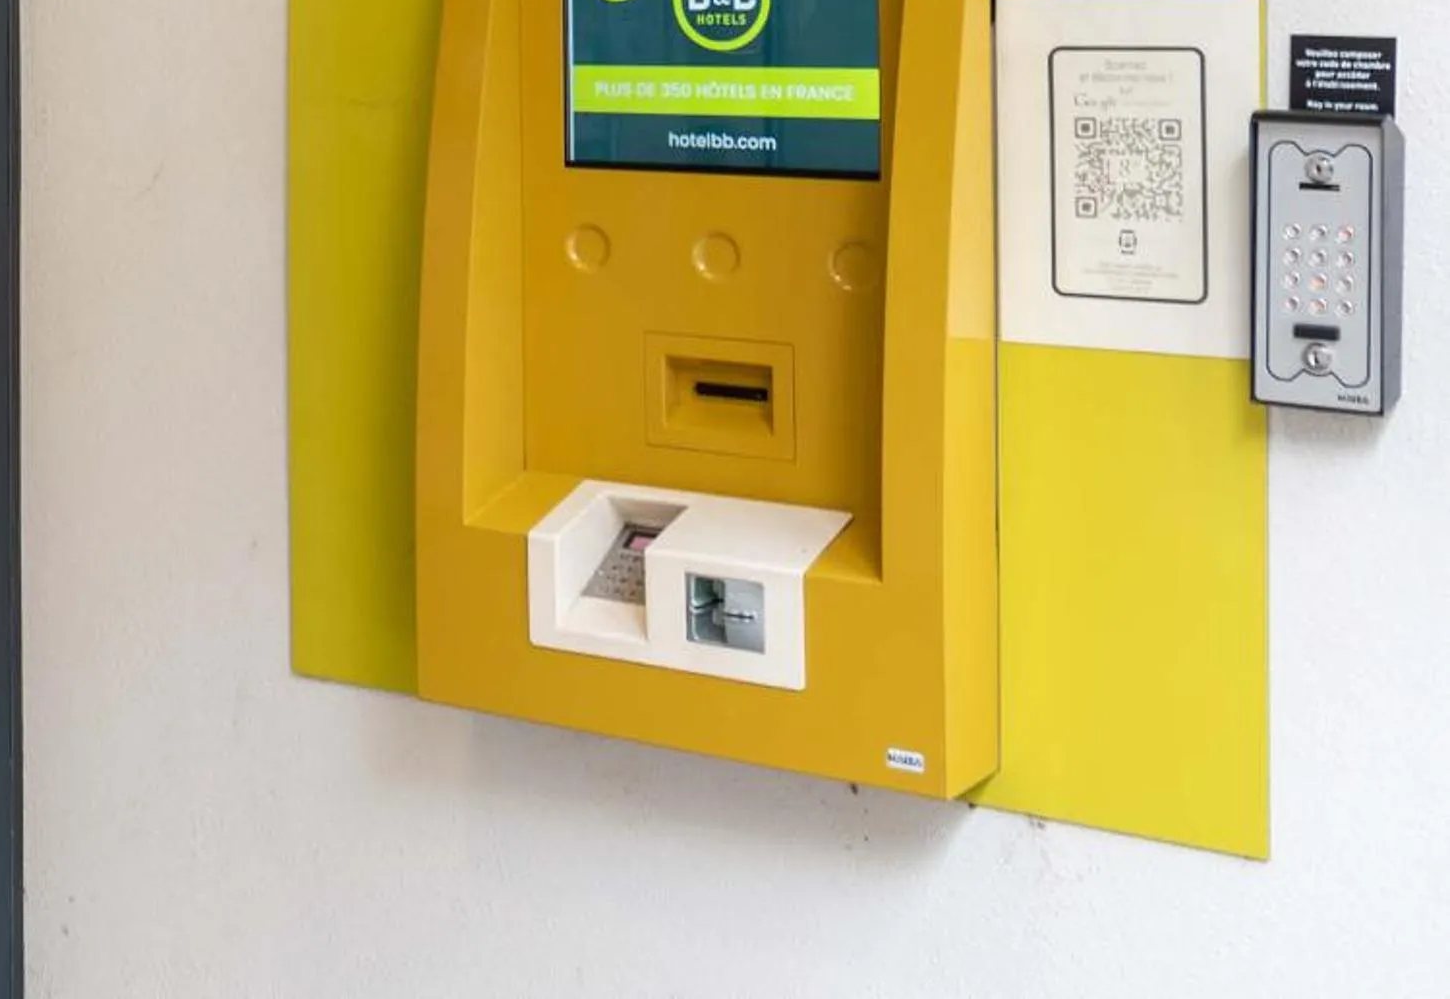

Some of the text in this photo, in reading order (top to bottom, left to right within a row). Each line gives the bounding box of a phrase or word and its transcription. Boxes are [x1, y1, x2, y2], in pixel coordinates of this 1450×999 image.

[696, 13, 747, 26] HOTELS
[594, 80, 856, 102] PLUS DE 350 HÔTELS EN FRANCE
[668, 131, 777, 151] hotelbb.com
